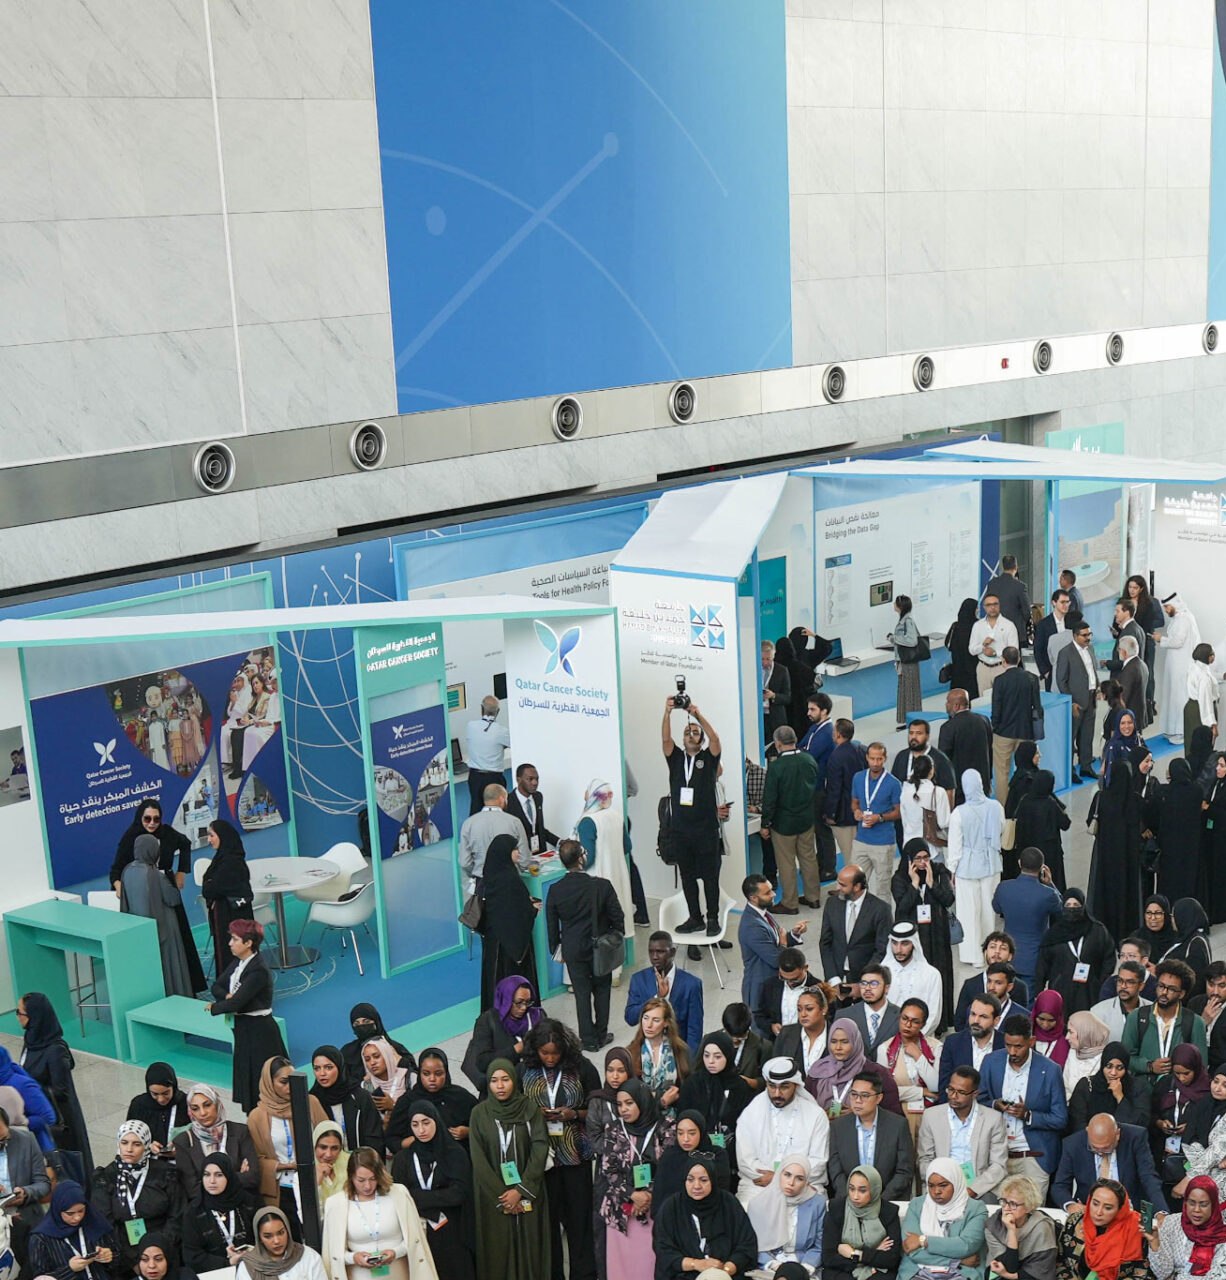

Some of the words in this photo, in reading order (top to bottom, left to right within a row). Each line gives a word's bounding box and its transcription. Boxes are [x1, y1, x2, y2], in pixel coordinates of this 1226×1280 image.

[825, 530, 847, 540] Bridging
[848, 526, 856, 535] the
[856, 526, 868, 534] Data
[870, 523, 880, 532] Gap
[552, 588, 561, 598] for
[562, 584, 582, 596] Health
[583, 580, 602, 592] Policy
[640, 657, 660, 665] Member
[665, 660, 678, 668] Qatar
[514, 678, 541, 690] Qatar
[542, 682, 574, 696] Cancer
[575, 686, 608, 702] Society
[518, 696, 550, 710] للسرطان
[552, 700, 580, 714] القطرية
[581, 704, 610, 718] الجمعية
[131, 779, 162, 795] الكشف
[81, 796, 102, 808] ينقذ
[103, 788, 130, 805] المبكر
[60, 803, 80, 814] حياة
[64, 814, 84, 826] Early
[85, 804, 121, 820] detection
[122, 799, 142, 810] saves
